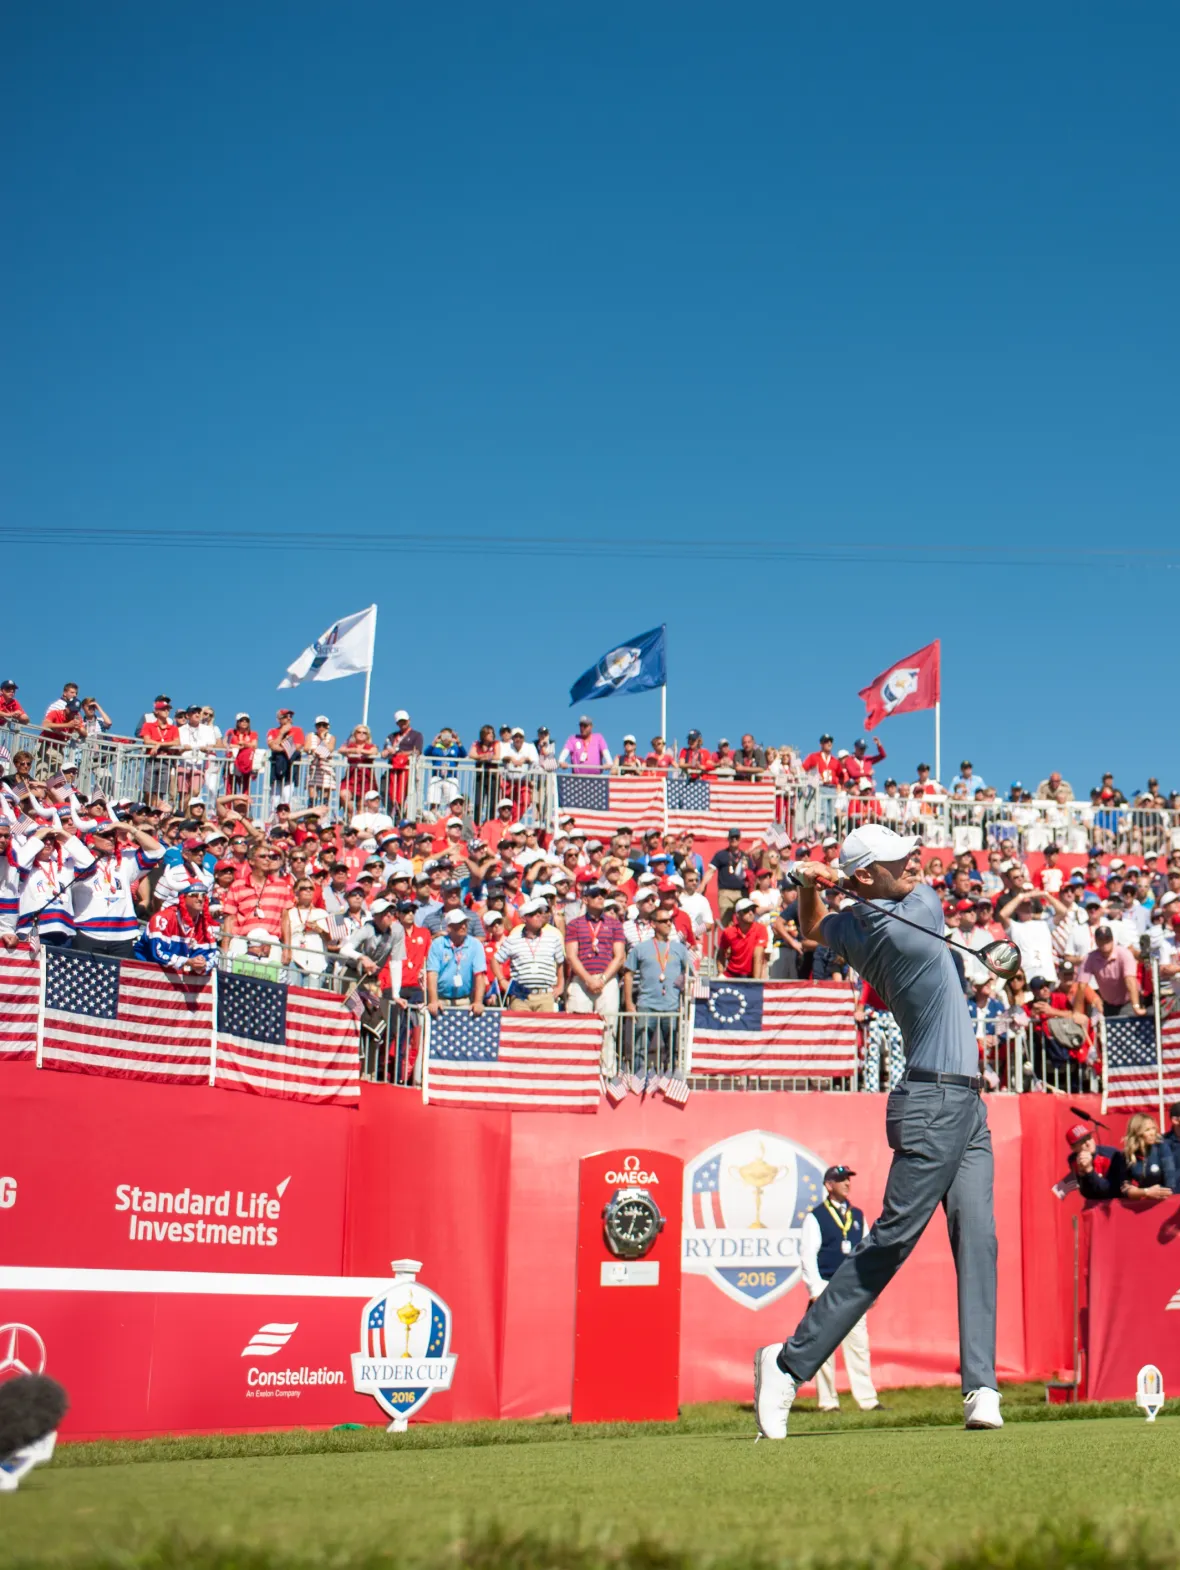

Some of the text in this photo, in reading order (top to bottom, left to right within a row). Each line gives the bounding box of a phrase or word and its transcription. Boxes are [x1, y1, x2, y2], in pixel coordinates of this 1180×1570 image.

[604, 1170, 660, 1184] OMEGA
[115, 1184, 281, 1220] Standard Life
[129, 1215, 278, 1247] Investments
[684, 1237, 772, 1258] RYDER
[737, 1272, 777, 1287] 2016
[247, 1366, 344, 1386] Constellation
[361, 1364, 448, 1381] RYDER CUP
[246, 1389, 255, 1398] An
[391, 1391, 416, 1404] 2016
